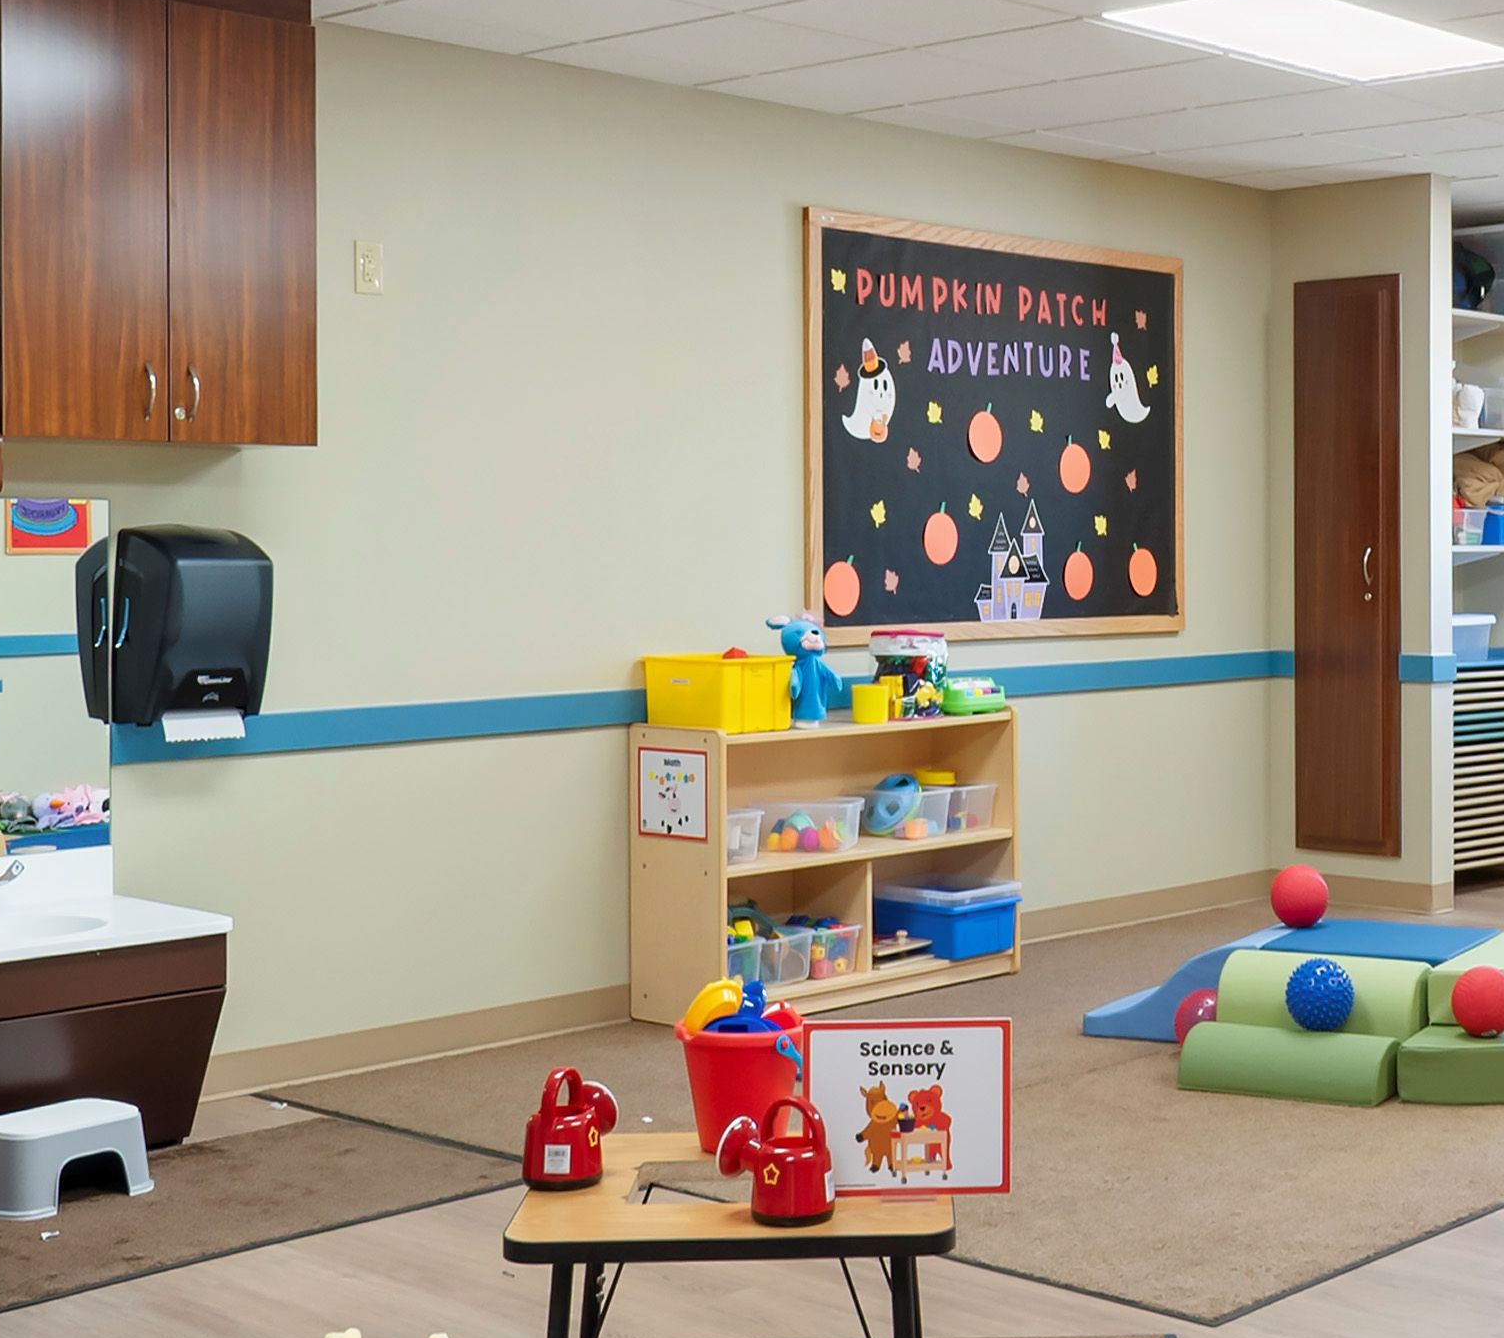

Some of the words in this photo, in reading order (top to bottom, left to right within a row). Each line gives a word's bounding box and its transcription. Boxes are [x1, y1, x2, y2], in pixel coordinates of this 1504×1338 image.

[855, 267, 1003, 315] PUMPKIN
[1017, 284, 1108, 327] PATCH
[926, 336, 1091, 382] ADVENTURE
[859, 1039, 935, 1057] Science
[940, 1040, 954, 1055] &
[867, 1061, 946, 1080] Sensory
